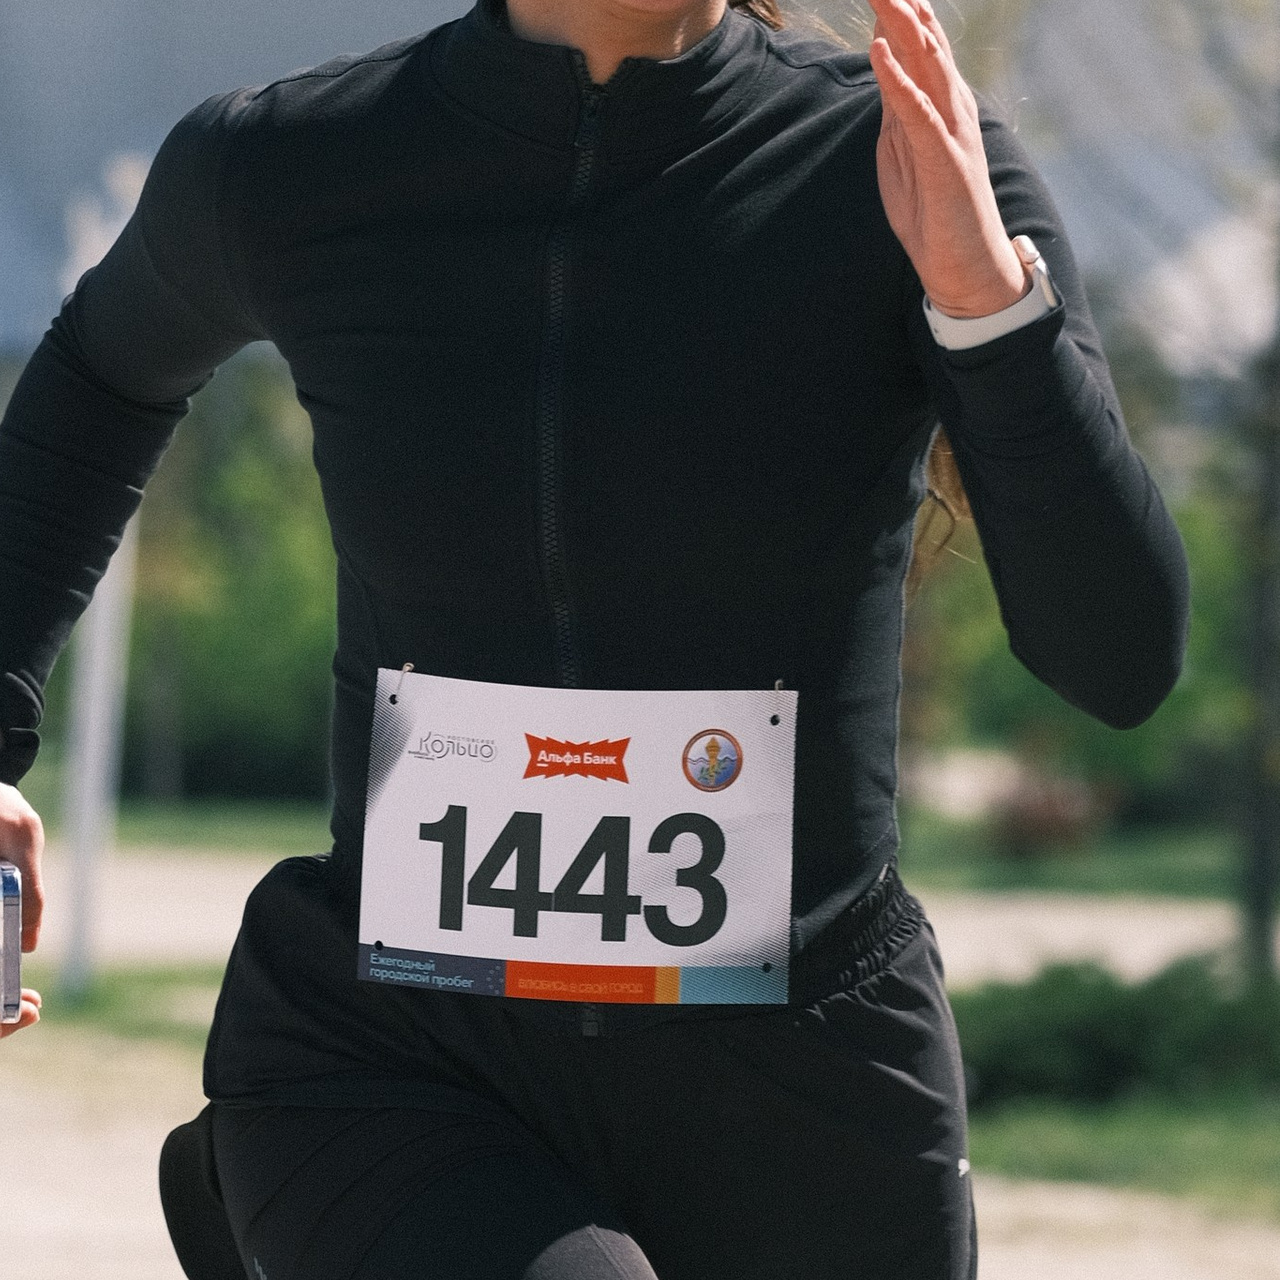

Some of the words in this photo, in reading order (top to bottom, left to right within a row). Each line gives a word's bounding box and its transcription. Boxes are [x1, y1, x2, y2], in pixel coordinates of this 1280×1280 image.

[536, 750, 581, 767] Альфа
[583, 752, 617, 765] Банк
[419, 804, 727, 947] 1443
[370, 953, 436, 971] Ежегодный
[369, 967, 429, 984] городской
[431, 975, 474, 988] пробег
